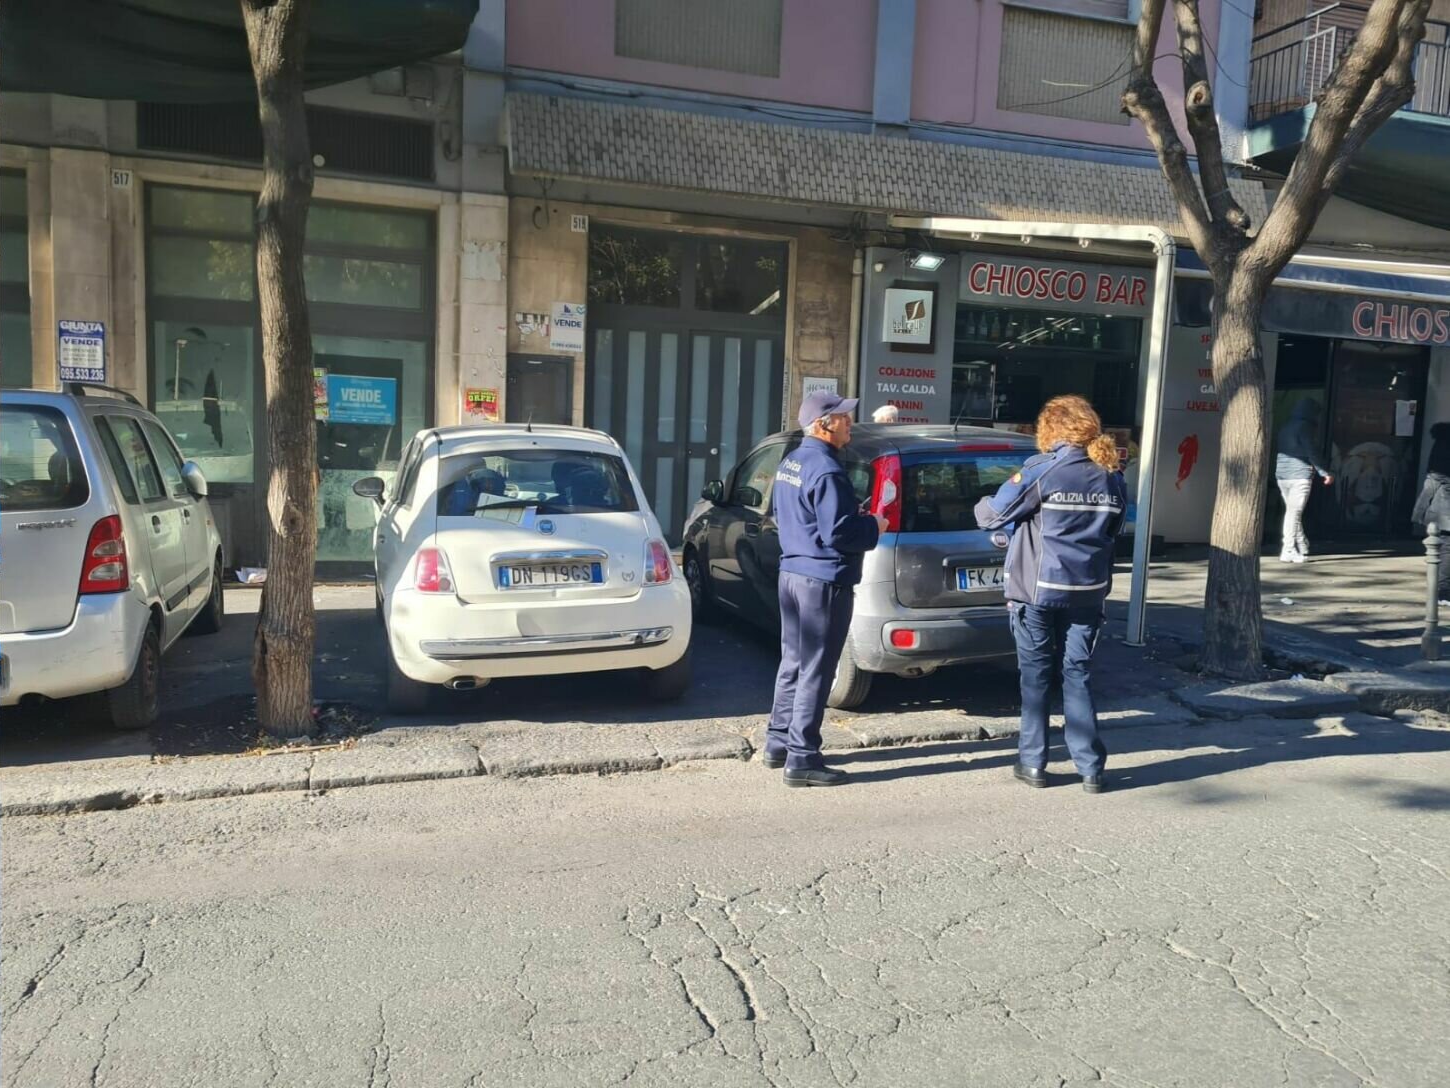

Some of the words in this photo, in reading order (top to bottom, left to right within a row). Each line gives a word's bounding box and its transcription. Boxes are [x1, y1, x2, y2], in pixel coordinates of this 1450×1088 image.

[114, 172, 130, 185] 517
[968, 261, 1088, 302] CHIOSCO
[1095, 273, 1148, 306] BAR
[60, 321, 103, 331] GIUNTA
[553, 319, 583, 328] VENDE
[1352, 301, 1450, 344] CHIOS
[63, 338, 100, 346] VENDE
[878, 366, 937, 379] COLAZIONE
[876, 382, 900, 393] TAV.
[901, 383, 937, 395] CALDA
[340, 387, 382, 404] VENDE
[1049, 491, 1085, 503] POLIZIA
[1086, 493, 1118, 505] LOCALE
[511, 566, 533, 585] DN
[541, 565, 591, 583] 119GS
[968, 569, 987, 587] FK
